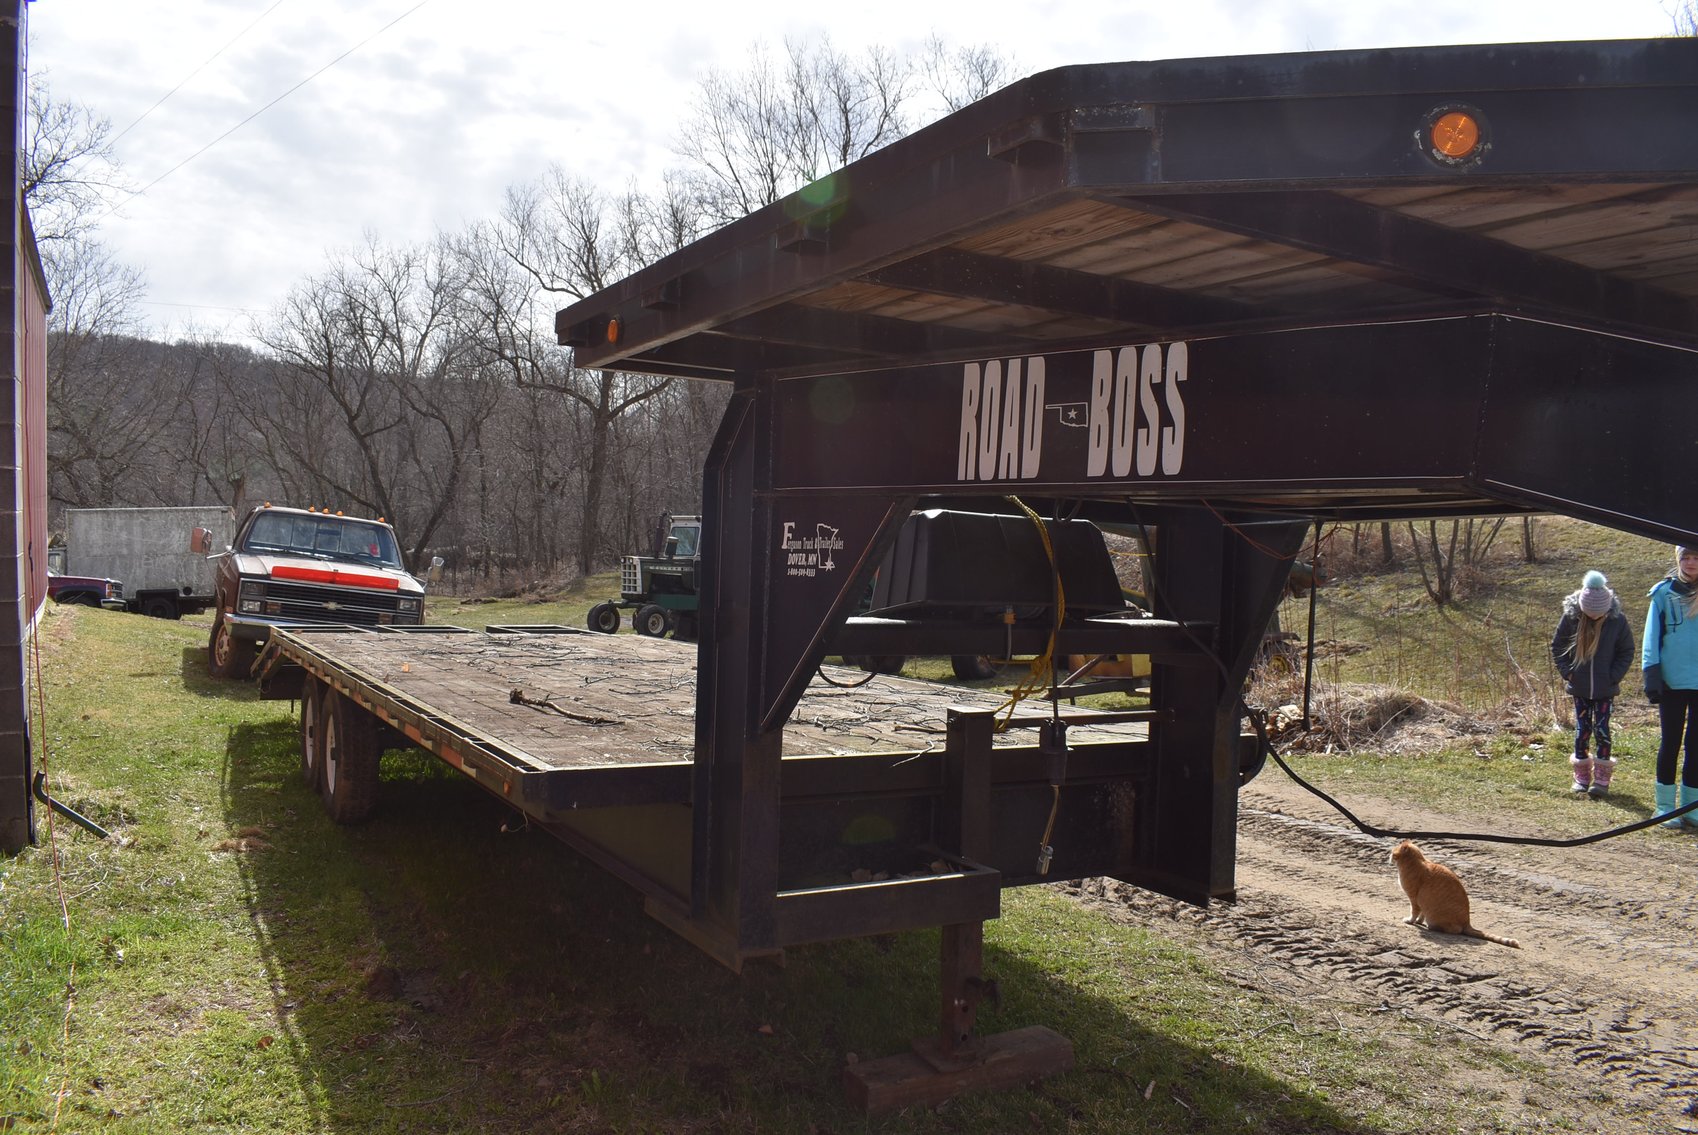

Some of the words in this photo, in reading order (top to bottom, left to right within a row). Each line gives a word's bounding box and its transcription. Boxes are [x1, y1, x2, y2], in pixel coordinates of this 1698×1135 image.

[957, 356, 1046, 481] ROAD
[1087, 341, 1188, 477] BOSS
[802, 537, 814, 549] Truck
[819, 536, 831, 549] Trailer
[832, 536, 844, 550] Sales
[787, 553, 807, 567] DOVER,
[807, 553, 818, 565] MN
